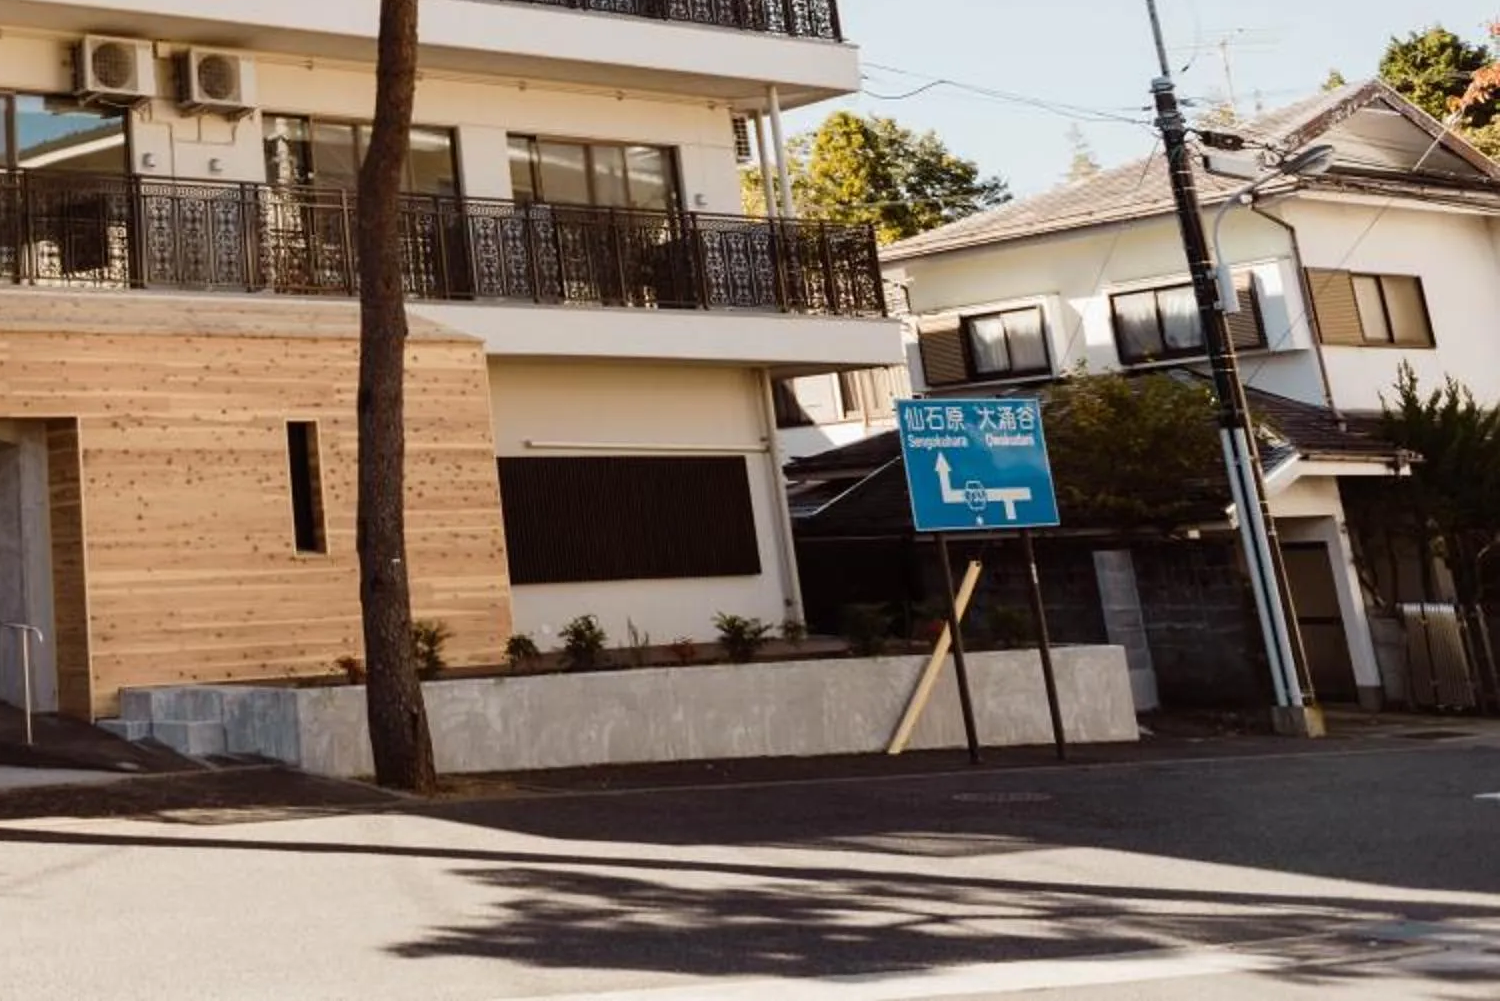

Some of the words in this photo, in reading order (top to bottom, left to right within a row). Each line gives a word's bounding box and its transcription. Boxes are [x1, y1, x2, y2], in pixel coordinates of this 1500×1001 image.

[905, 406, 965, 431] 仙石原
[978, 405, 1035, 431] 大涌谷
